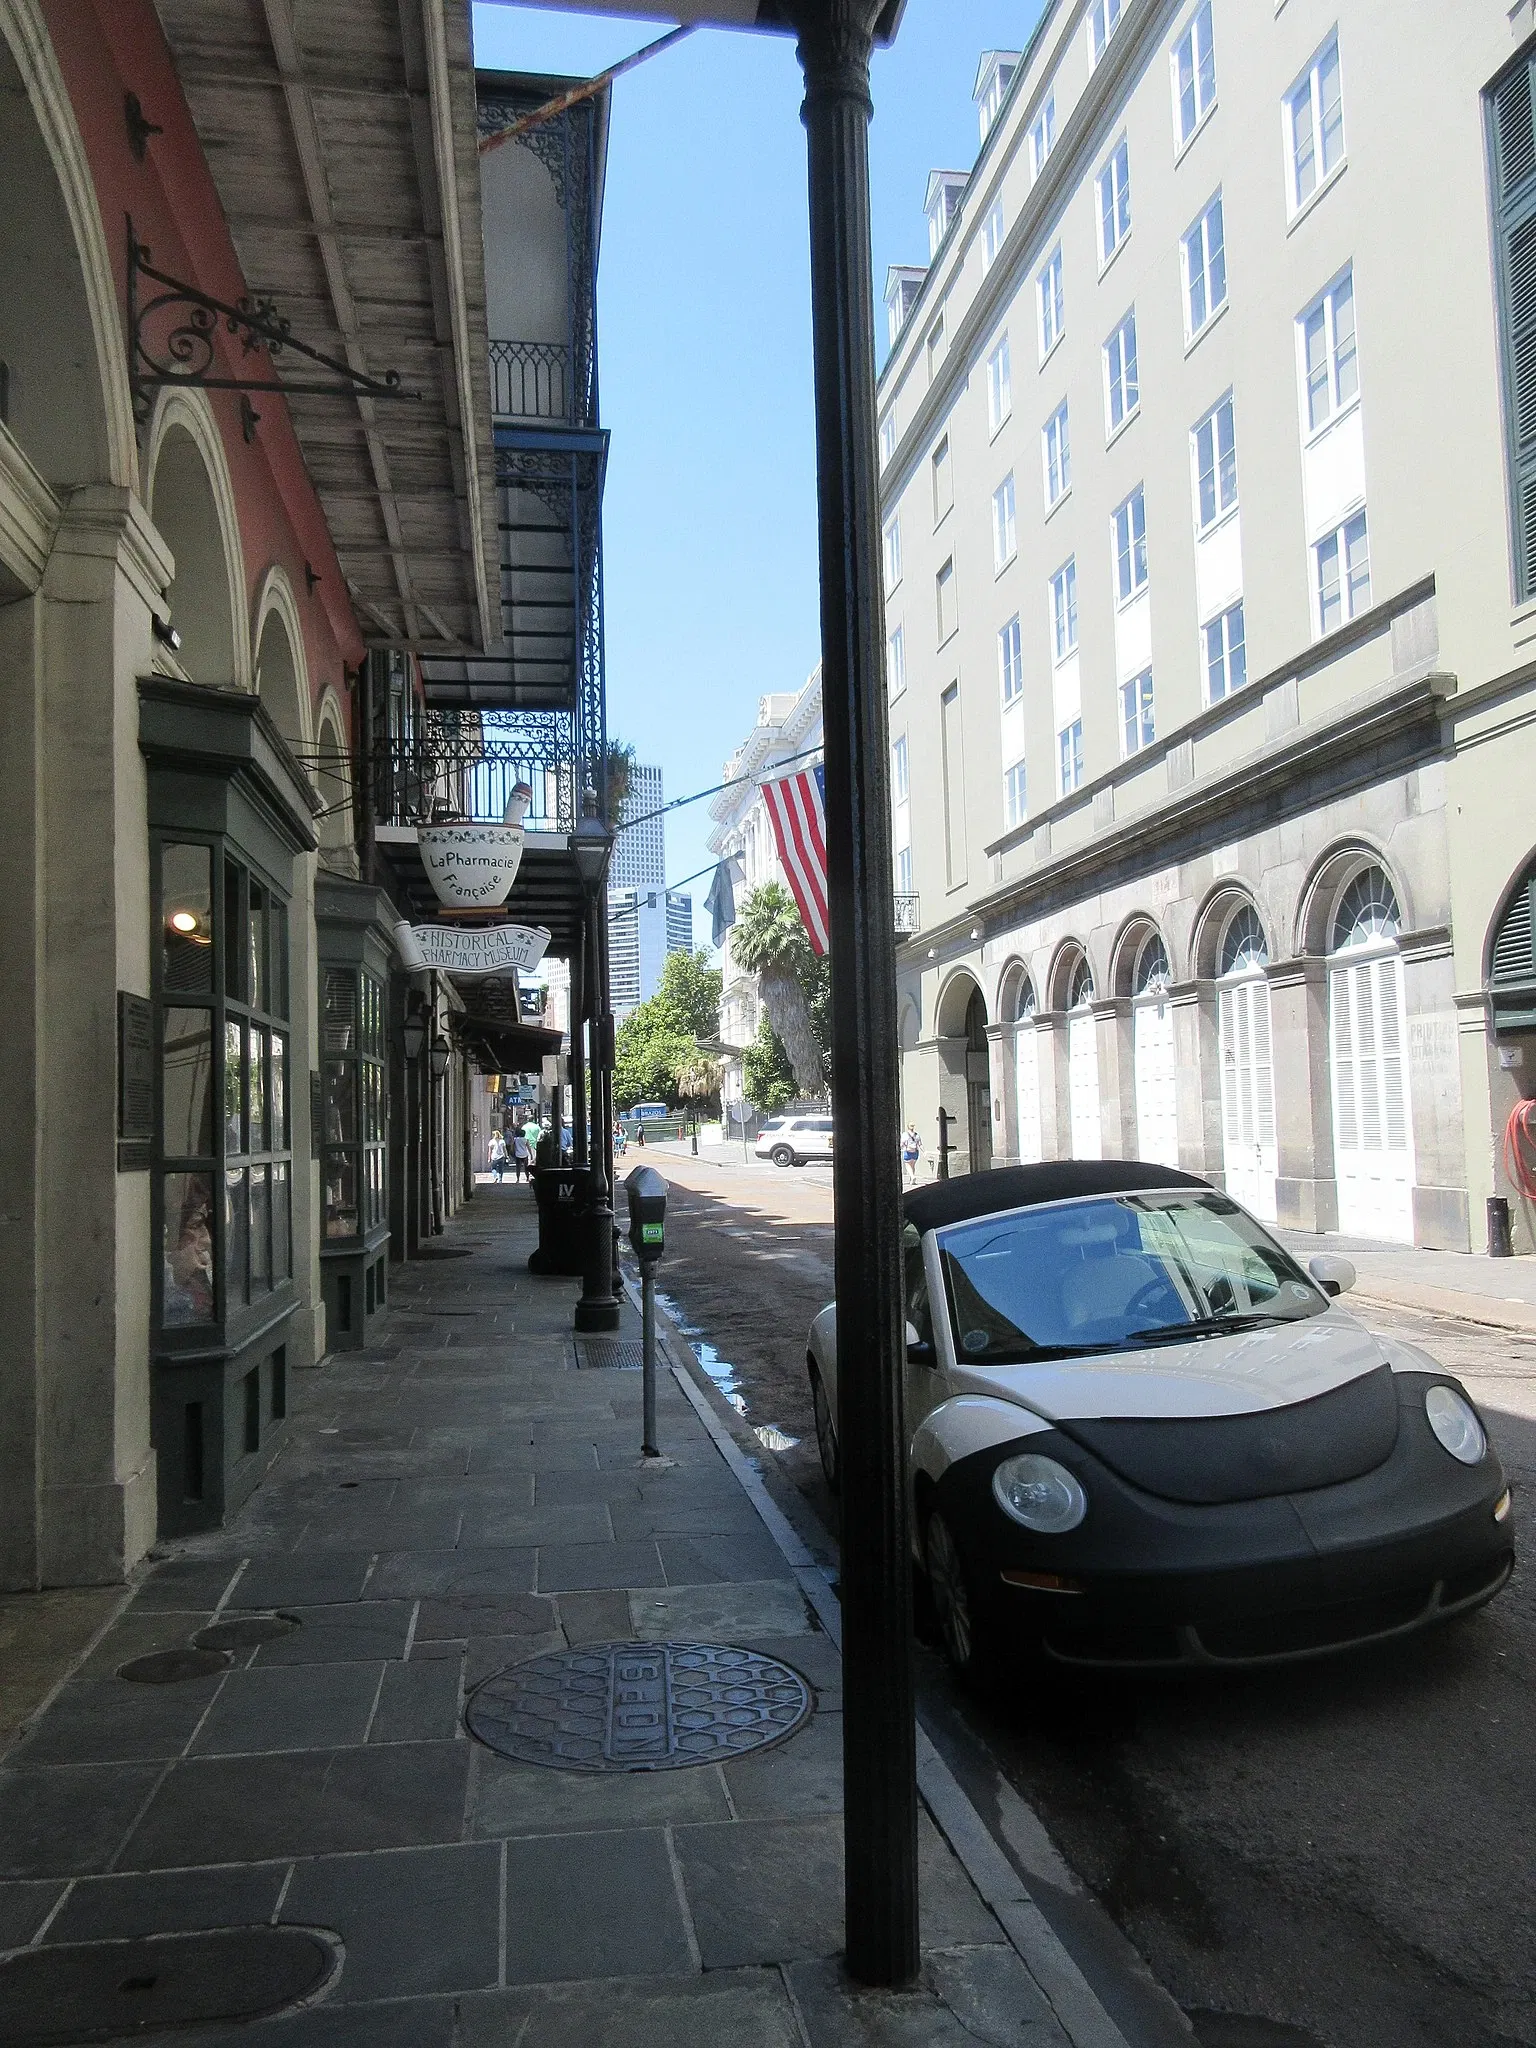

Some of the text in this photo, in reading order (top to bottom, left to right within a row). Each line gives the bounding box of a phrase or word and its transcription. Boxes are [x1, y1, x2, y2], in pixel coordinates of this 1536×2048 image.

[446, 852, 514, 869] Pharmacie
[442, 873, 502, 900] Française
[430, 931, 514, 951] HISTORICAL
[421, 946, 529, 967] PHARMACY MUSEUM
